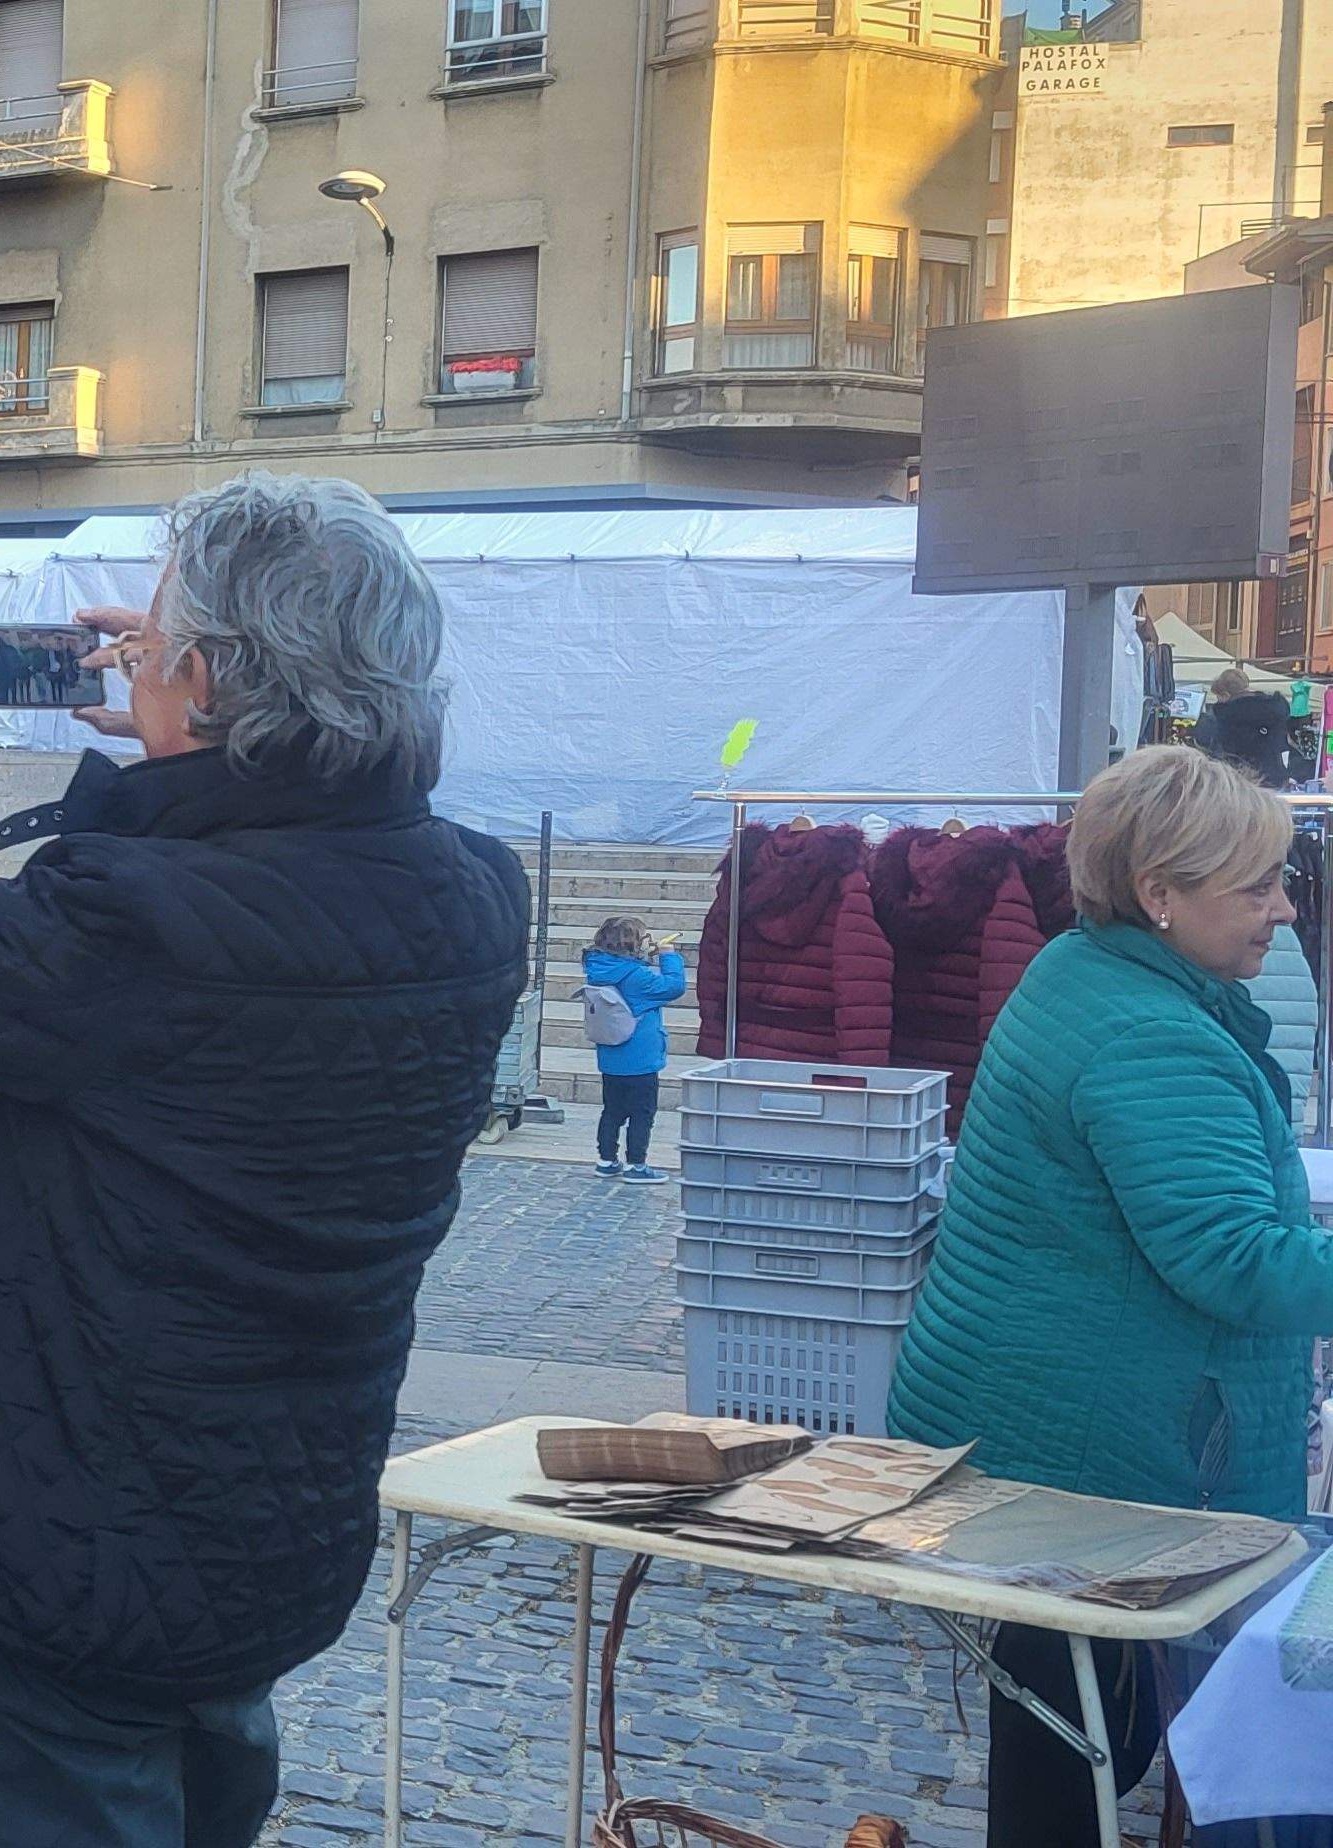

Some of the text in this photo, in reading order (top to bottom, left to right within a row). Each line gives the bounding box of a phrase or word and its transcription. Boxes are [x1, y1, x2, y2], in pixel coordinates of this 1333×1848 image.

[1030, 46, 1099, 59] HOSTAL
[1022, 58, 1105, 71] PALAFOX
[1026, 77, 1100, 91] GARAGE
